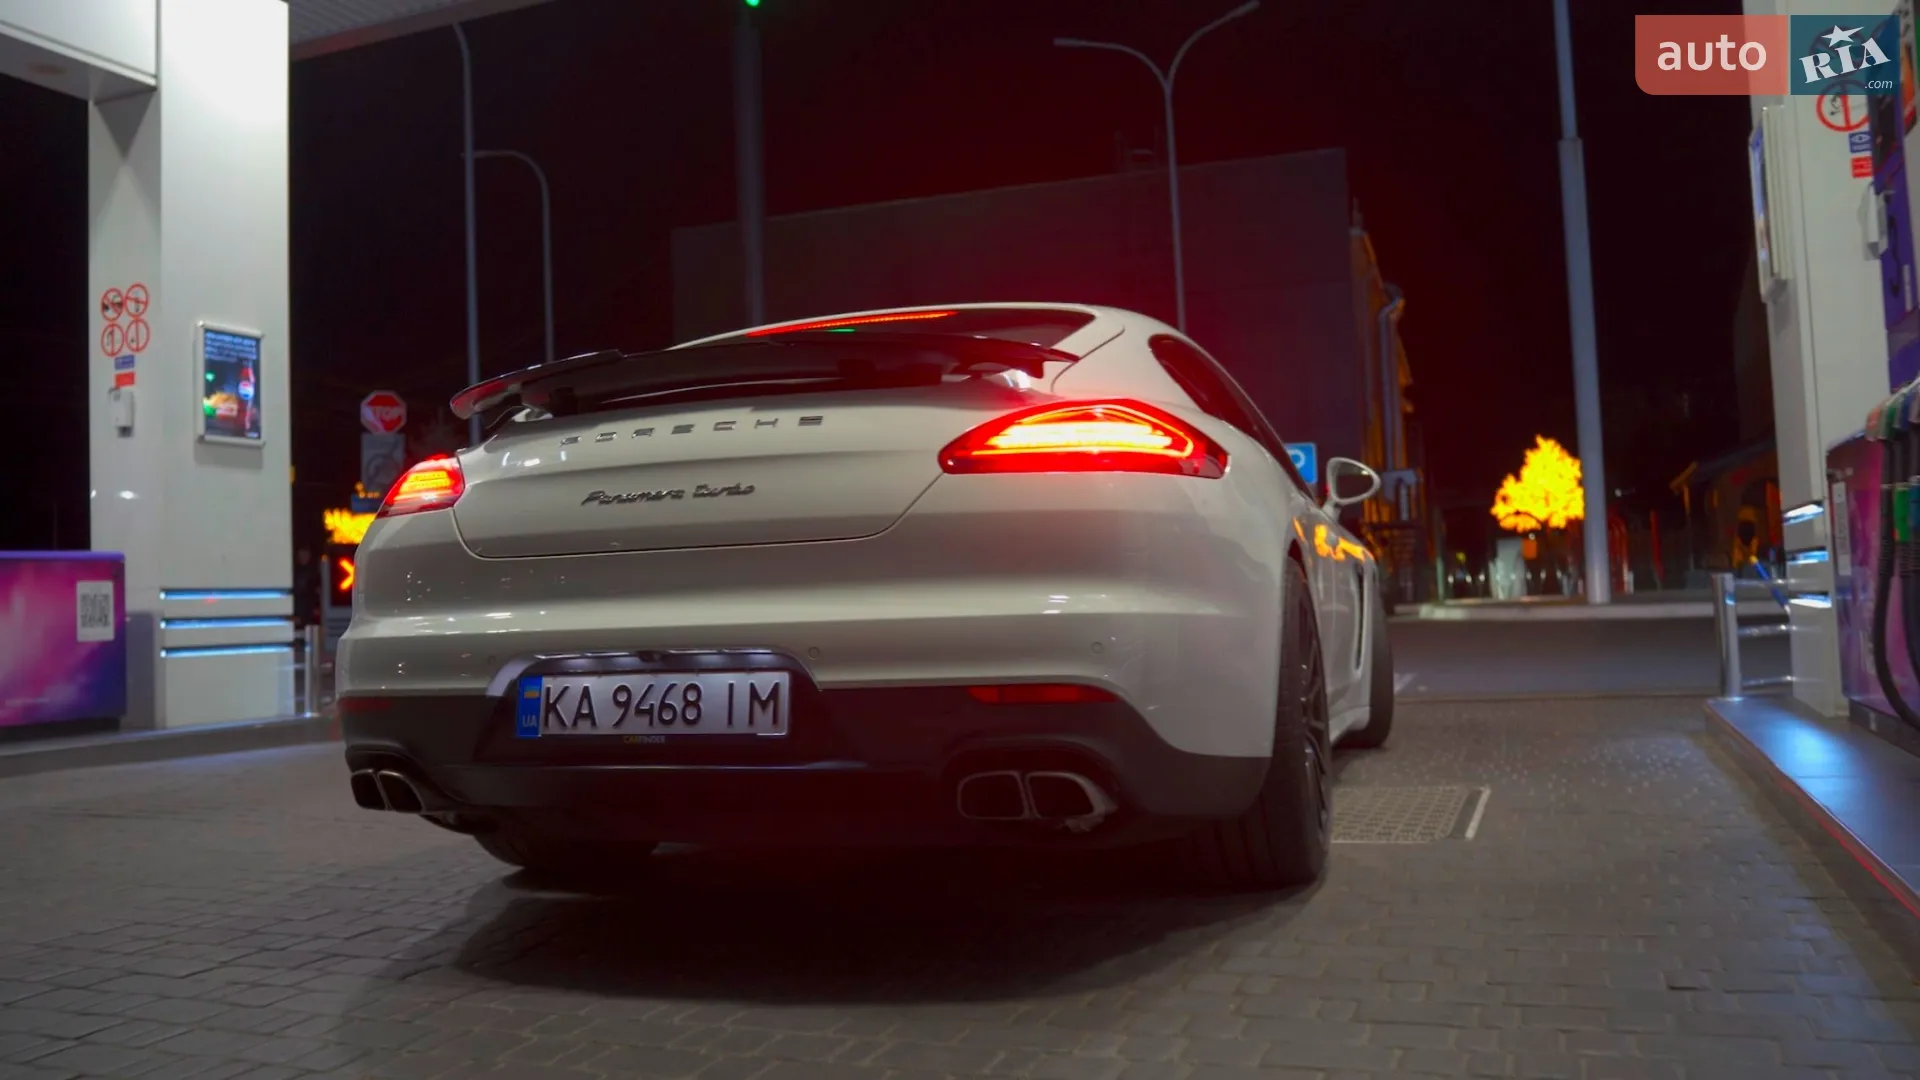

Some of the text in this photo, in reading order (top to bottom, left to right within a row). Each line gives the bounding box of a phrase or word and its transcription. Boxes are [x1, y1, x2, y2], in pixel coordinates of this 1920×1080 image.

[560, 415, 824, 448] PORSCHE
[580, 489, 686, 507] Panamera
[543, 684, 598, 730] KA
[612, 682, 703, 729] 9468
[521, 715, 538, 729] UA
